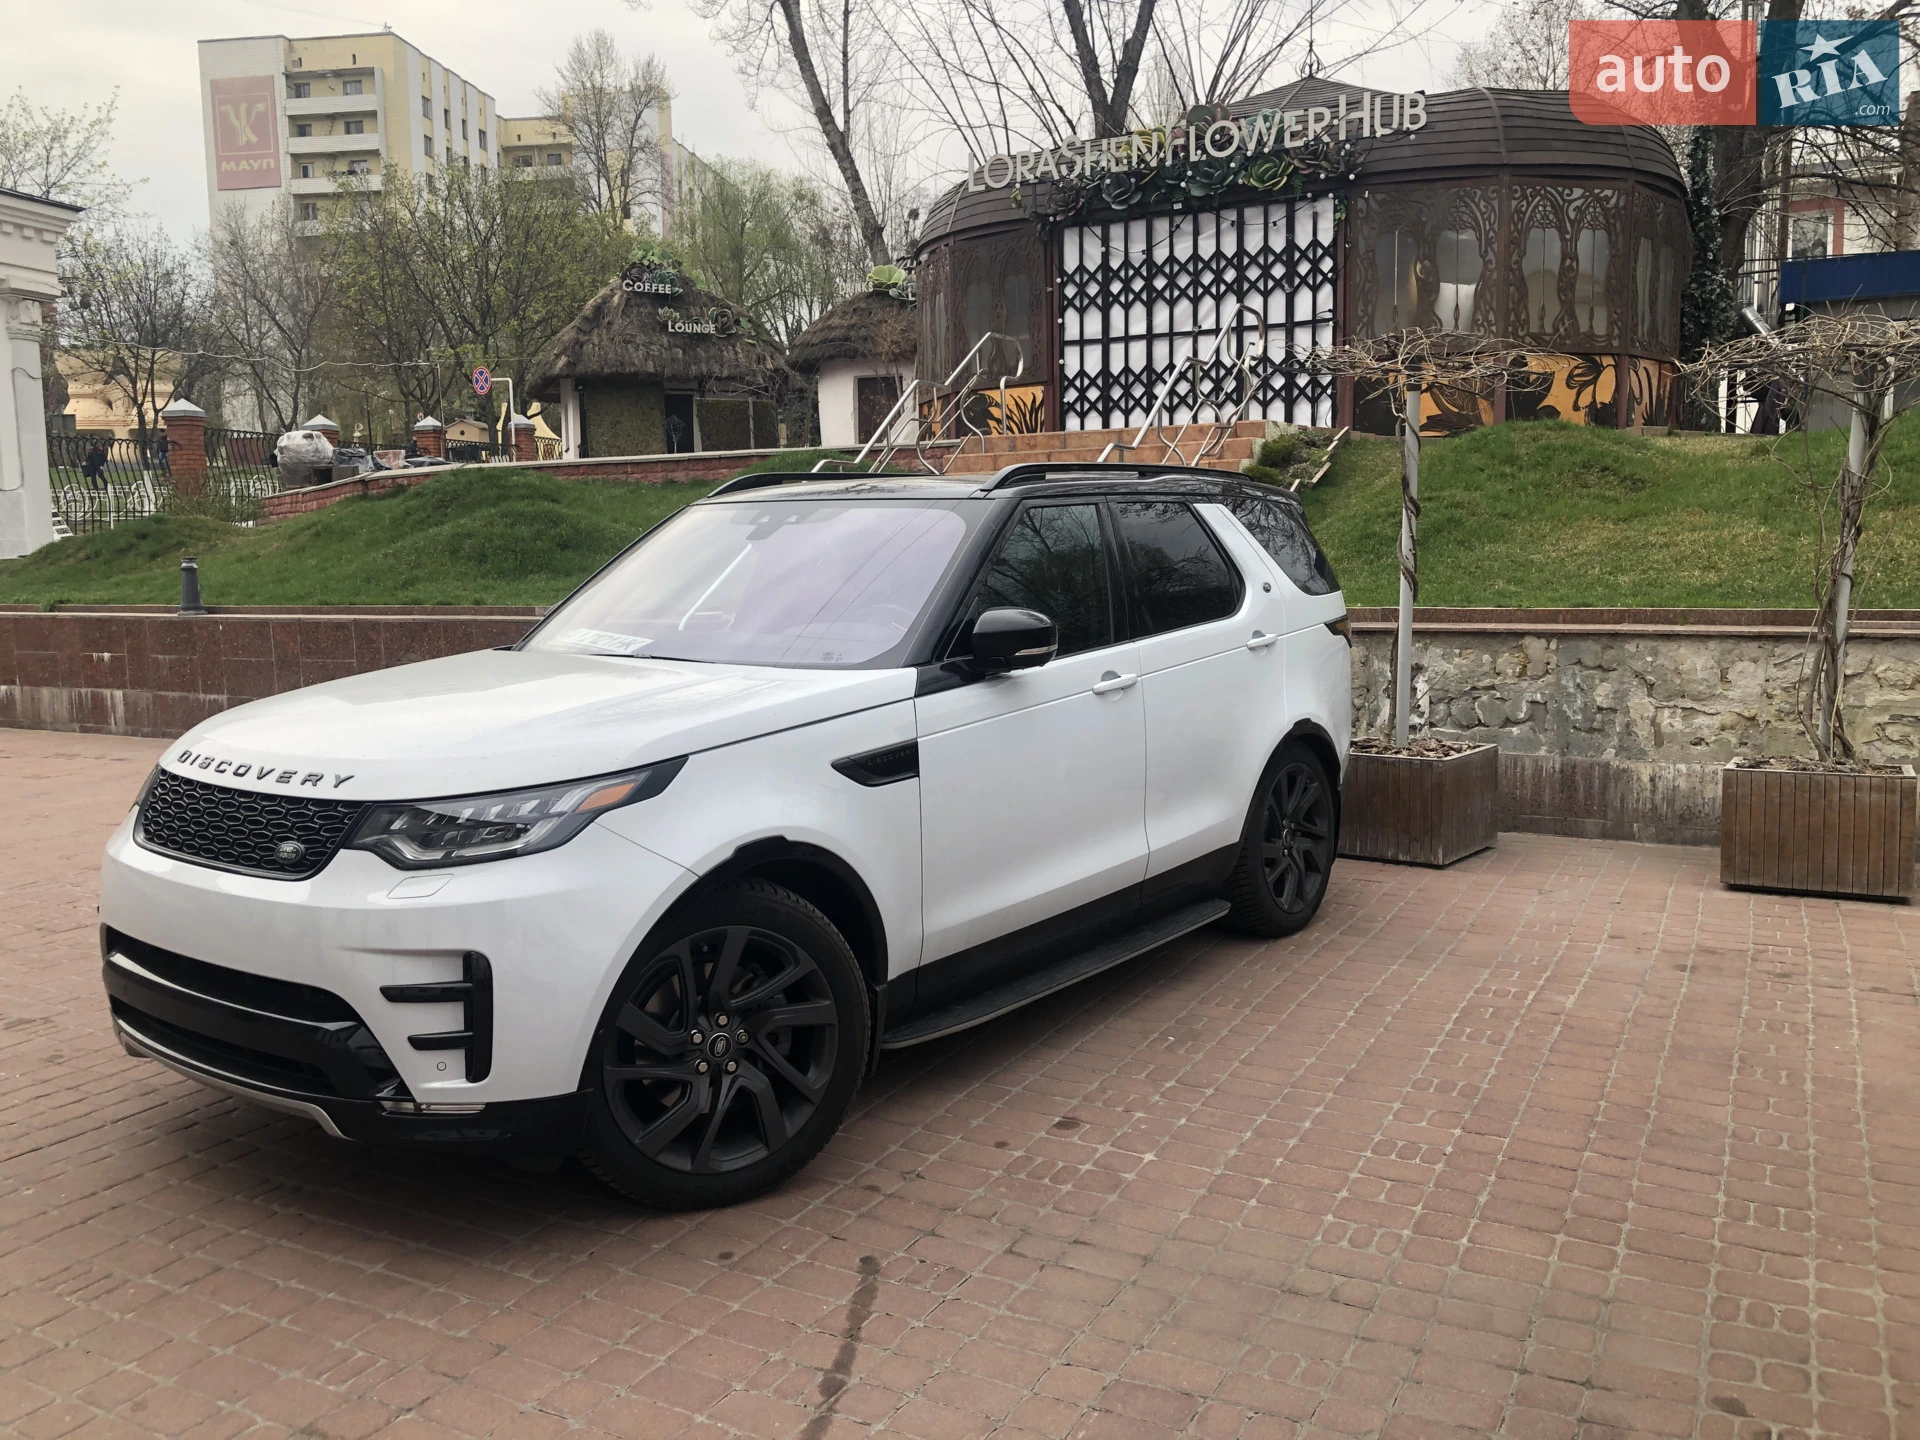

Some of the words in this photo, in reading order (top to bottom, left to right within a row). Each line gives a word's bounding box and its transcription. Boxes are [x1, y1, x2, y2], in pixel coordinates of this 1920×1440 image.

[221, 159, 275, 172] МАУП
[622, 280, 672, 294] COFFEE
[839, 281, 874, 295] DRINKS
[668, 320, 716, 334] LOUNGE
[177, 749, 355, 789] DISCOVERY
